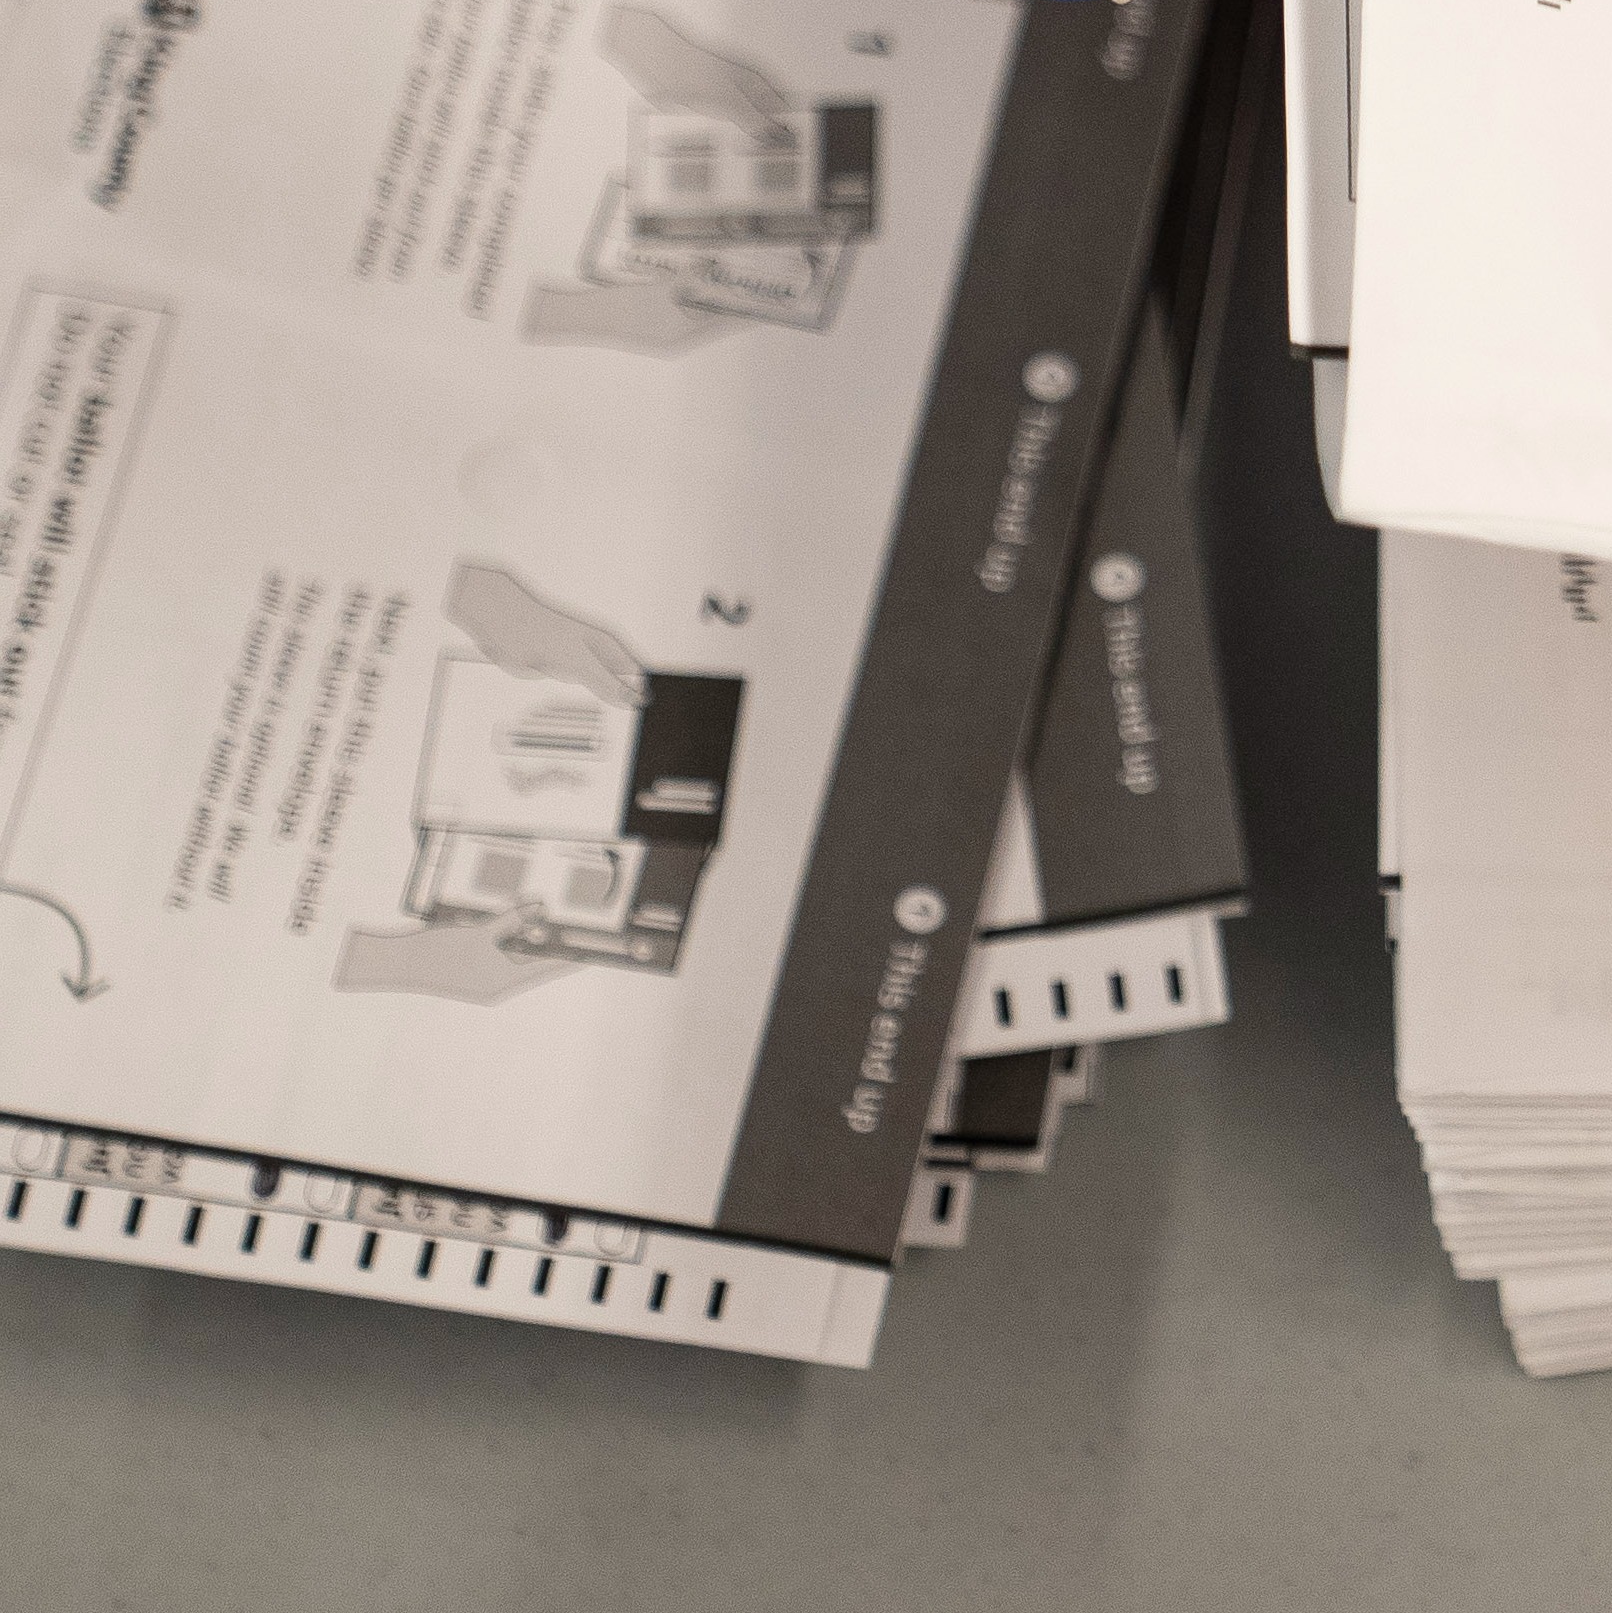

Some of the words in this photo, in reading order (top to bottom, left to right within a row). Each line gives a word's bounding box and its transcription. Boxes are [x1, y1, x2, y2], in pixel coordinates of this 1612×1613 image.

[1005, 409, 1057, 473] This
[991, 479, 1033, 543] end
[975, 545, 1015, 591] up
[1103, 608, 1142, 676] This
[1115, 678, 1155, 744] end
[1117, 748, 1159, 794] up
[877, 942, 928, 1009] This
[860, 1014, 903, 1083] end
[841, 1087, 884, 1134] up
